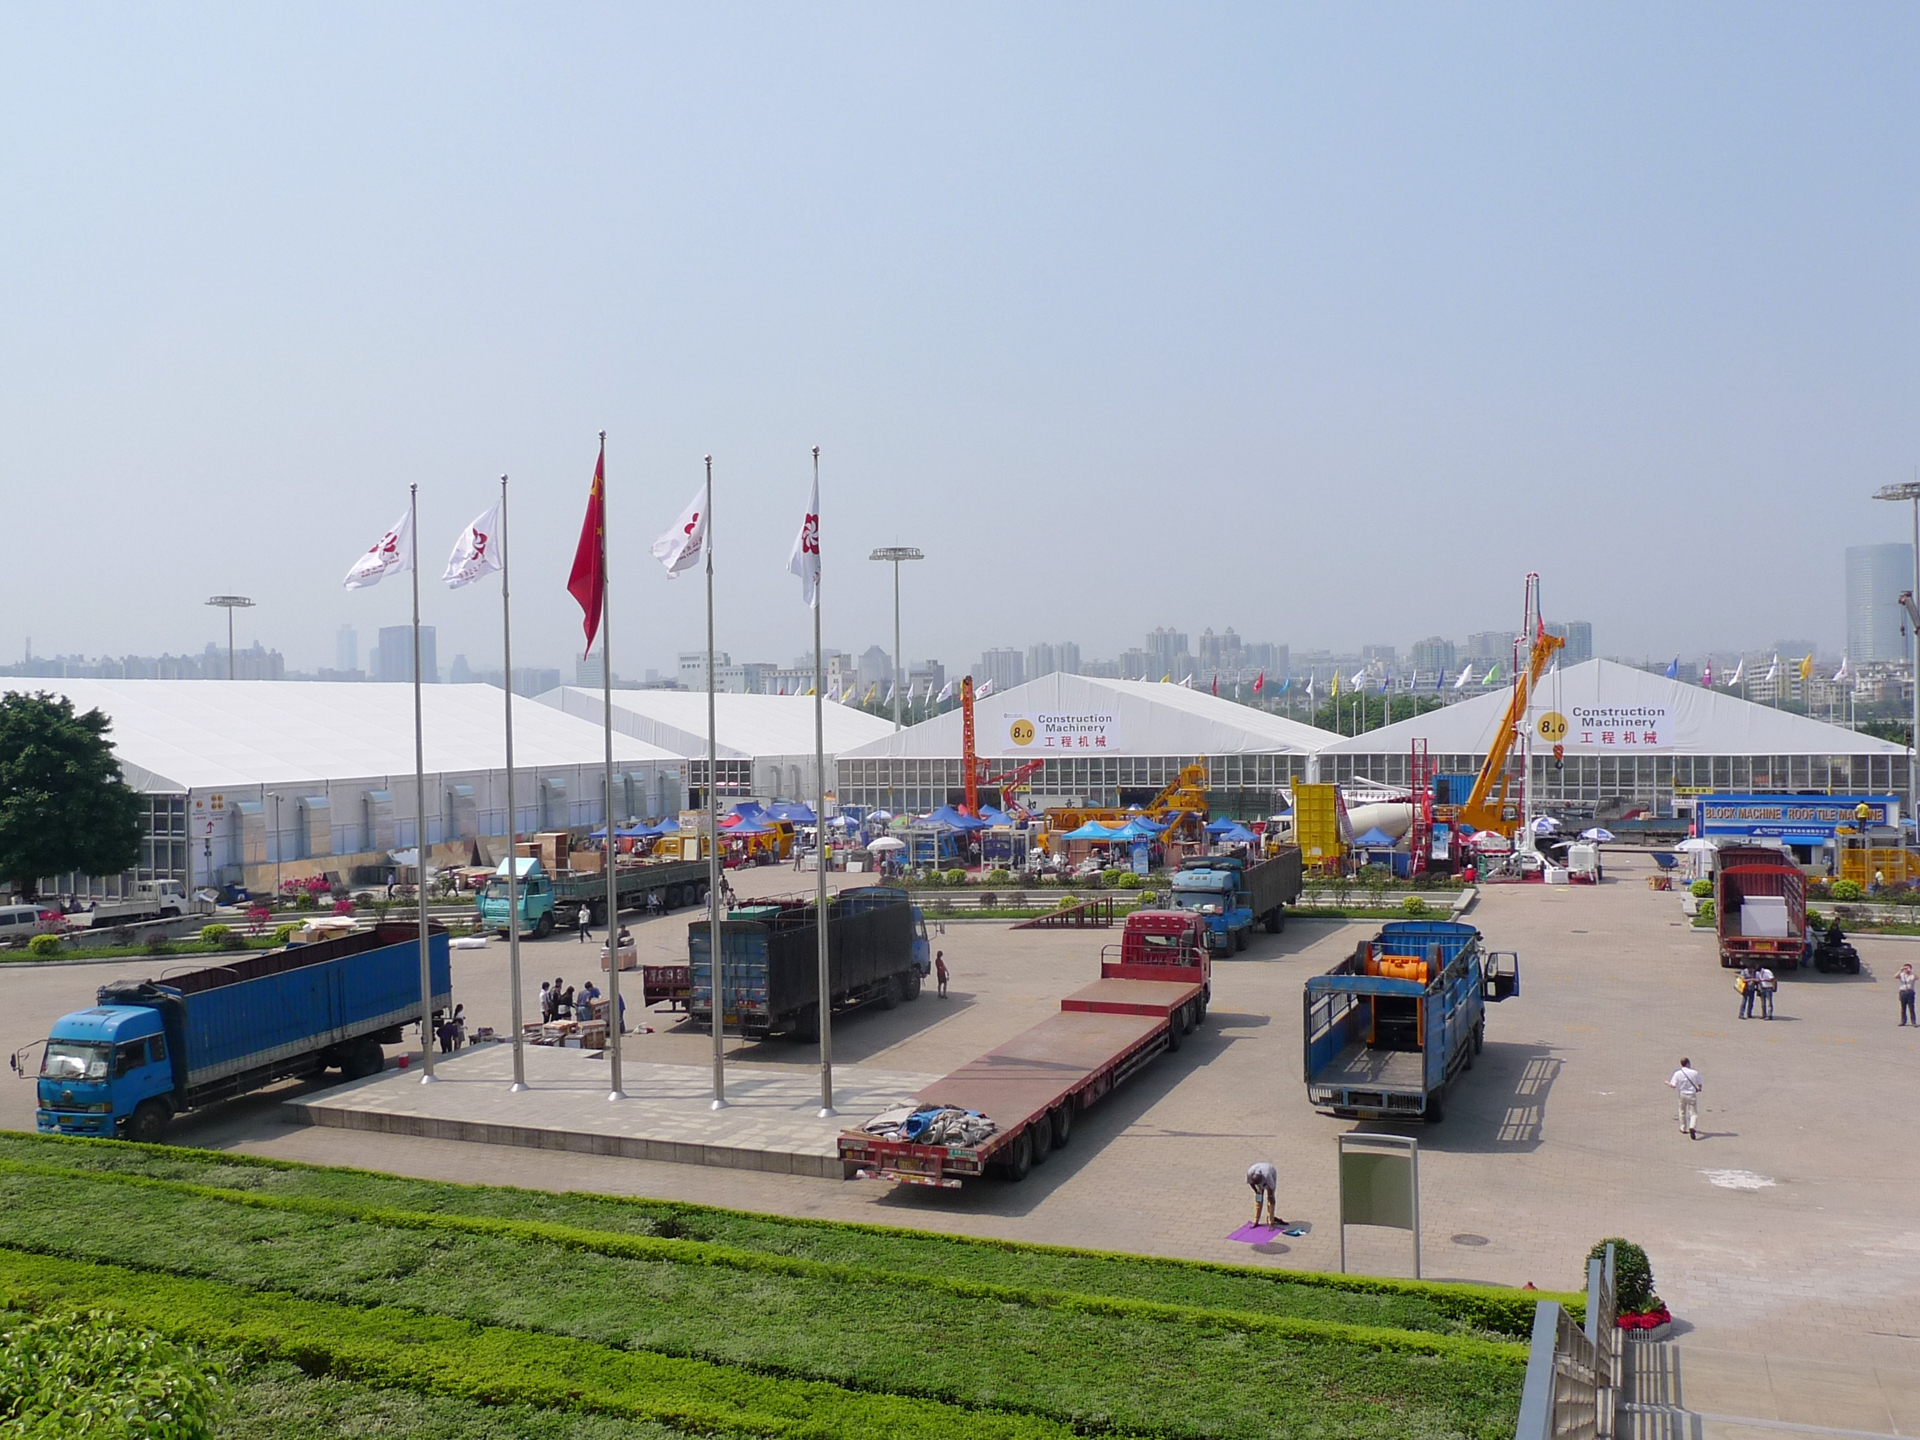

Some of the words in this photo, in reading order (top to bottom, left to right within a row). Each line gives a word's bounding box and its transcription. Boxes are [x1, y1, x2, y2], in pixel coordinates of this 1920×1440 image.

[1572, 706, 1665, 717] Construction
[1038, 714, 1112, 724] Construction
[1581, 717, 1656, 728] Machinery
[1045, 723, 1106, 734] Machinery
[1541, 720, 1565, 733] 8.0
[1013, 727, 1033, 738] 8.0
[1580, 731, 1657, 744] 工程机械
[1044, 736, 1107, 748] 工程机械
[1705, 807, 1736, 819] BLOCK
[1738, 808, 1782, 820] MACHINE
[1788, 808, 1815, 821] ROOF
[1816, 809, 1837, 821] TILE
